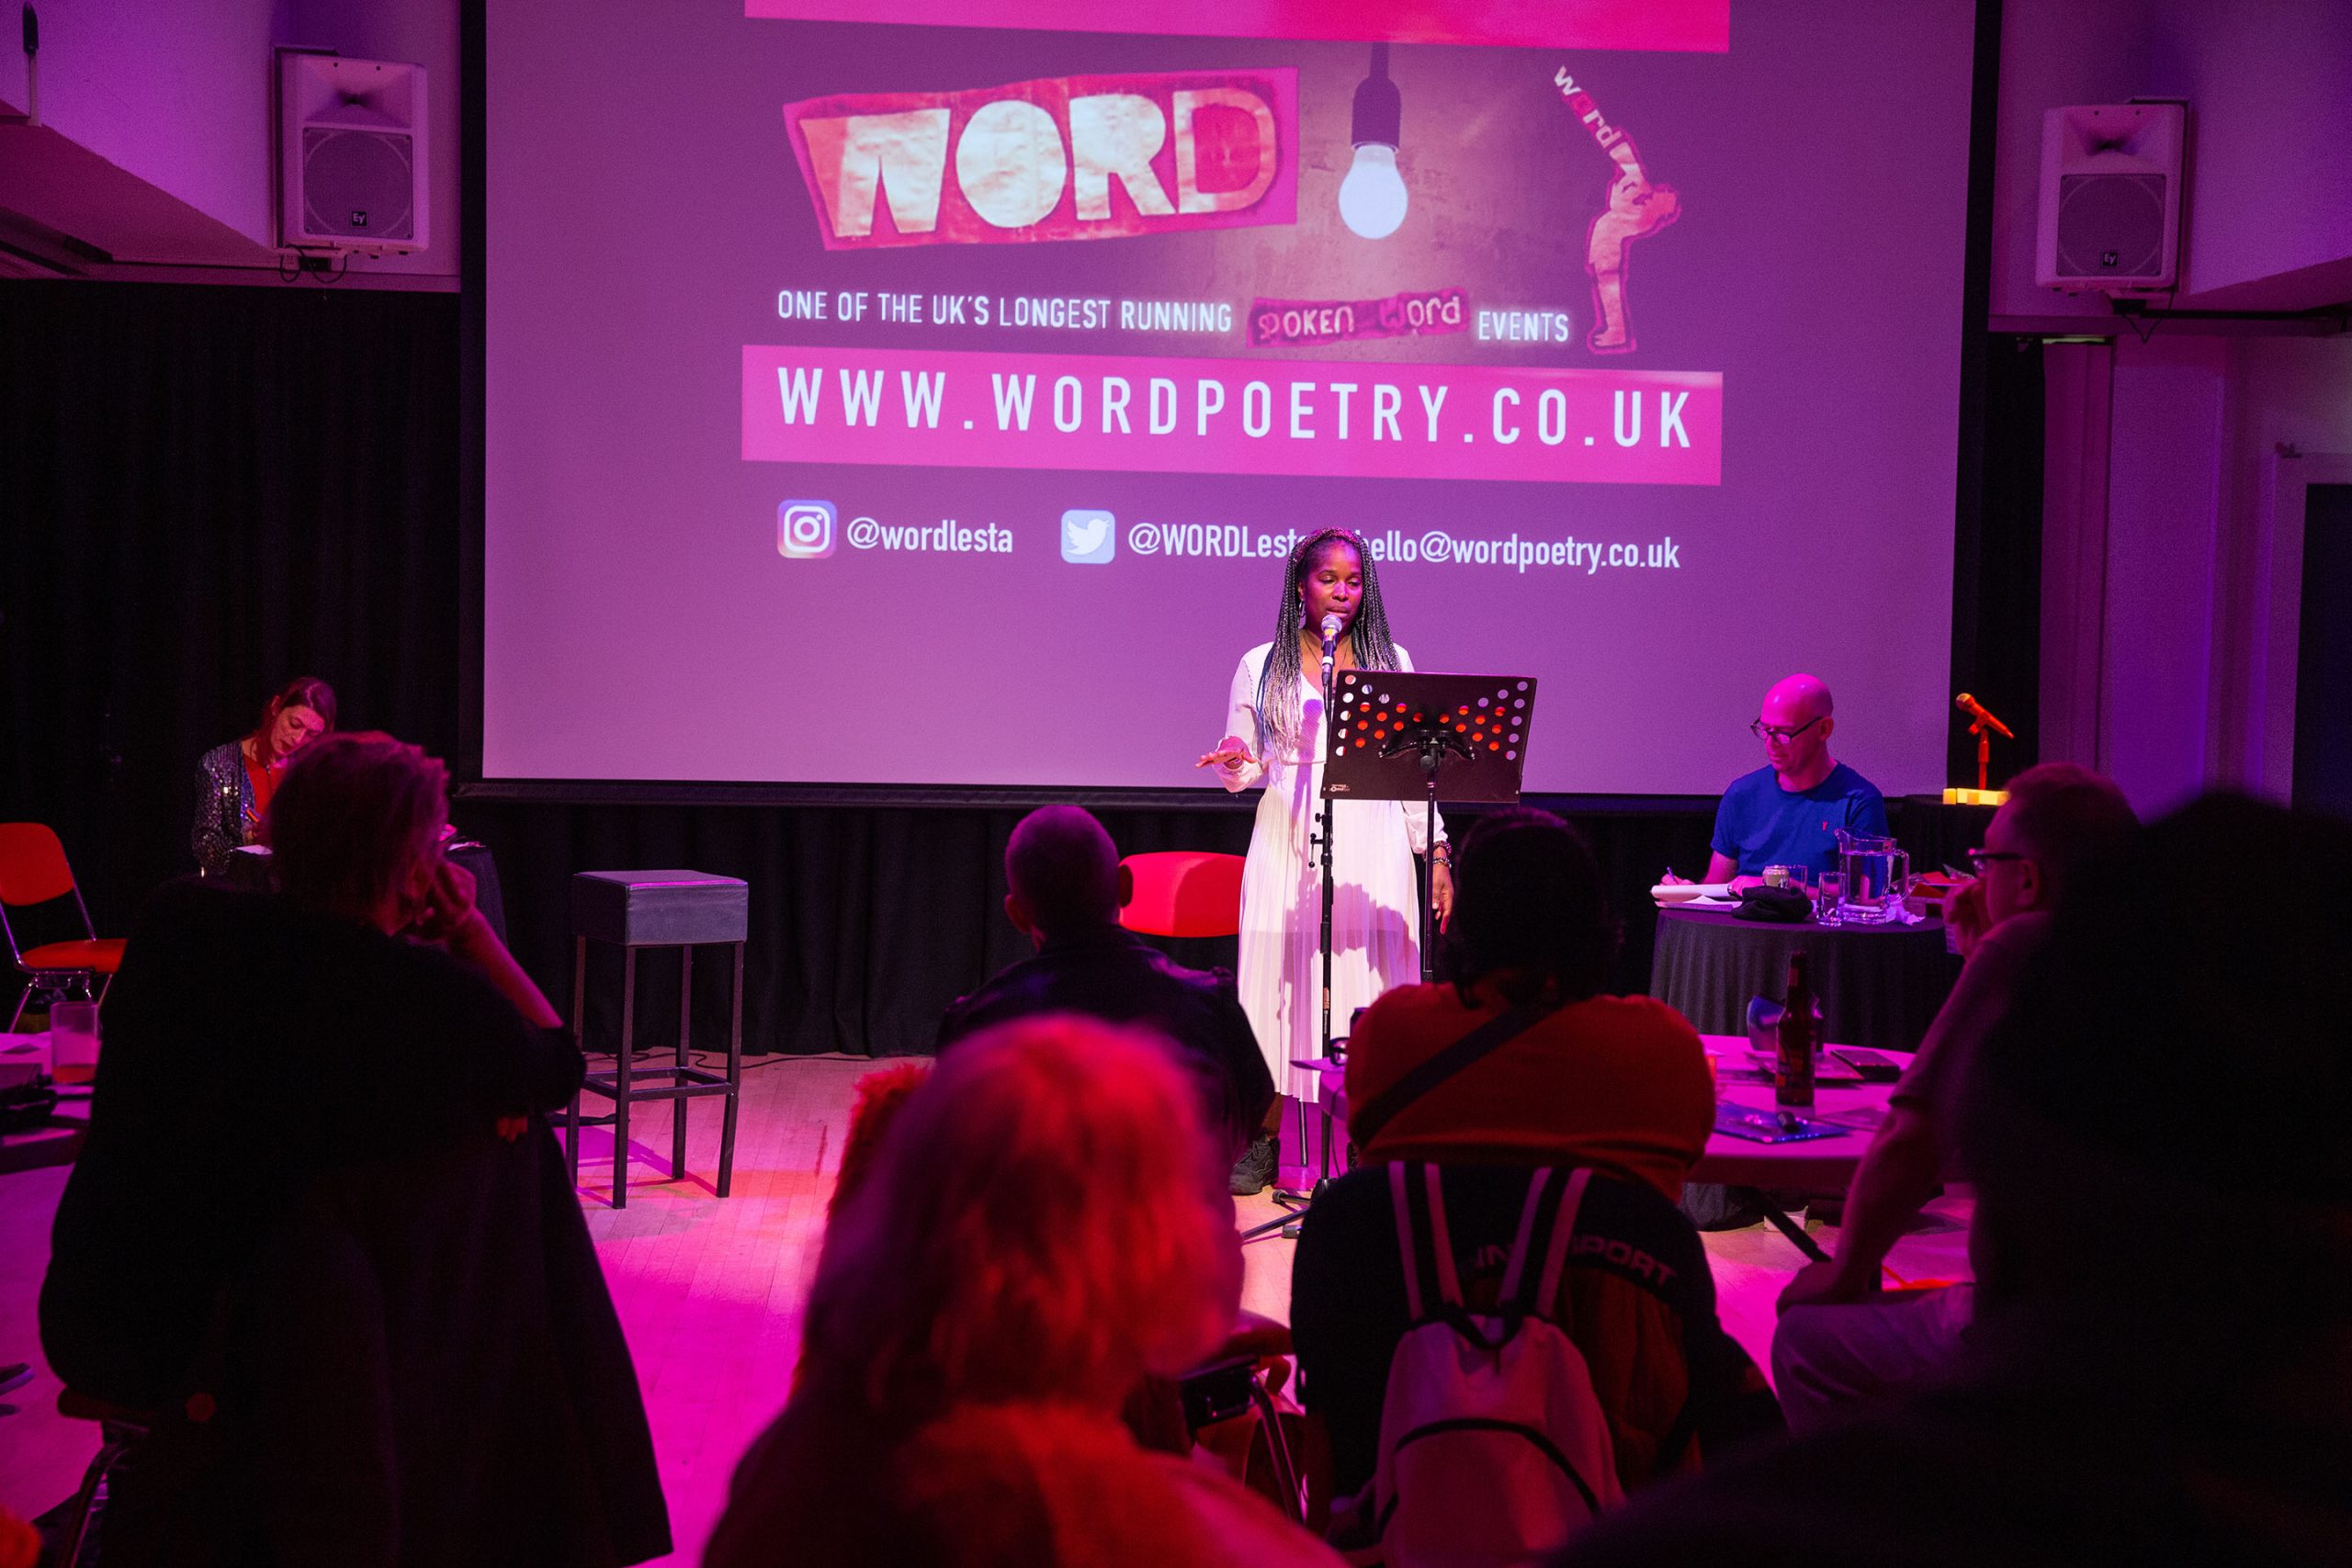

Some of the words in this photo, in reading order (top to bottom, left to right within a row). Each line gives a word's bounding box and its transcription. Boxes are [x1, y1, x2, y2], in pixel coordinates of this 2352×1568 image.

[1555, 65, 1622, 148] word
[799, 88, 1275, 237] WORD
[779, 291, 828, 320] ONE
[839, 293, 869, 322] OF
[878, 294, 923, 323] THE
[934, 296, 989, 326] UK'S
[1001, 298, 1112, 330] LONGEST
[1122, 301, 1232, 333] RUNNING
[1478, 311, 1569, 343] EVENTS
[778, 367, 1690, 448] WWW.WORDPOETRY.CO.UK
[847, 517, 1013, 553] @wordlesta
[1129, 524, 1307, 559] @WORDLest
[1355, 530, 1680, 575] ello@wordpoetry.co.uk
